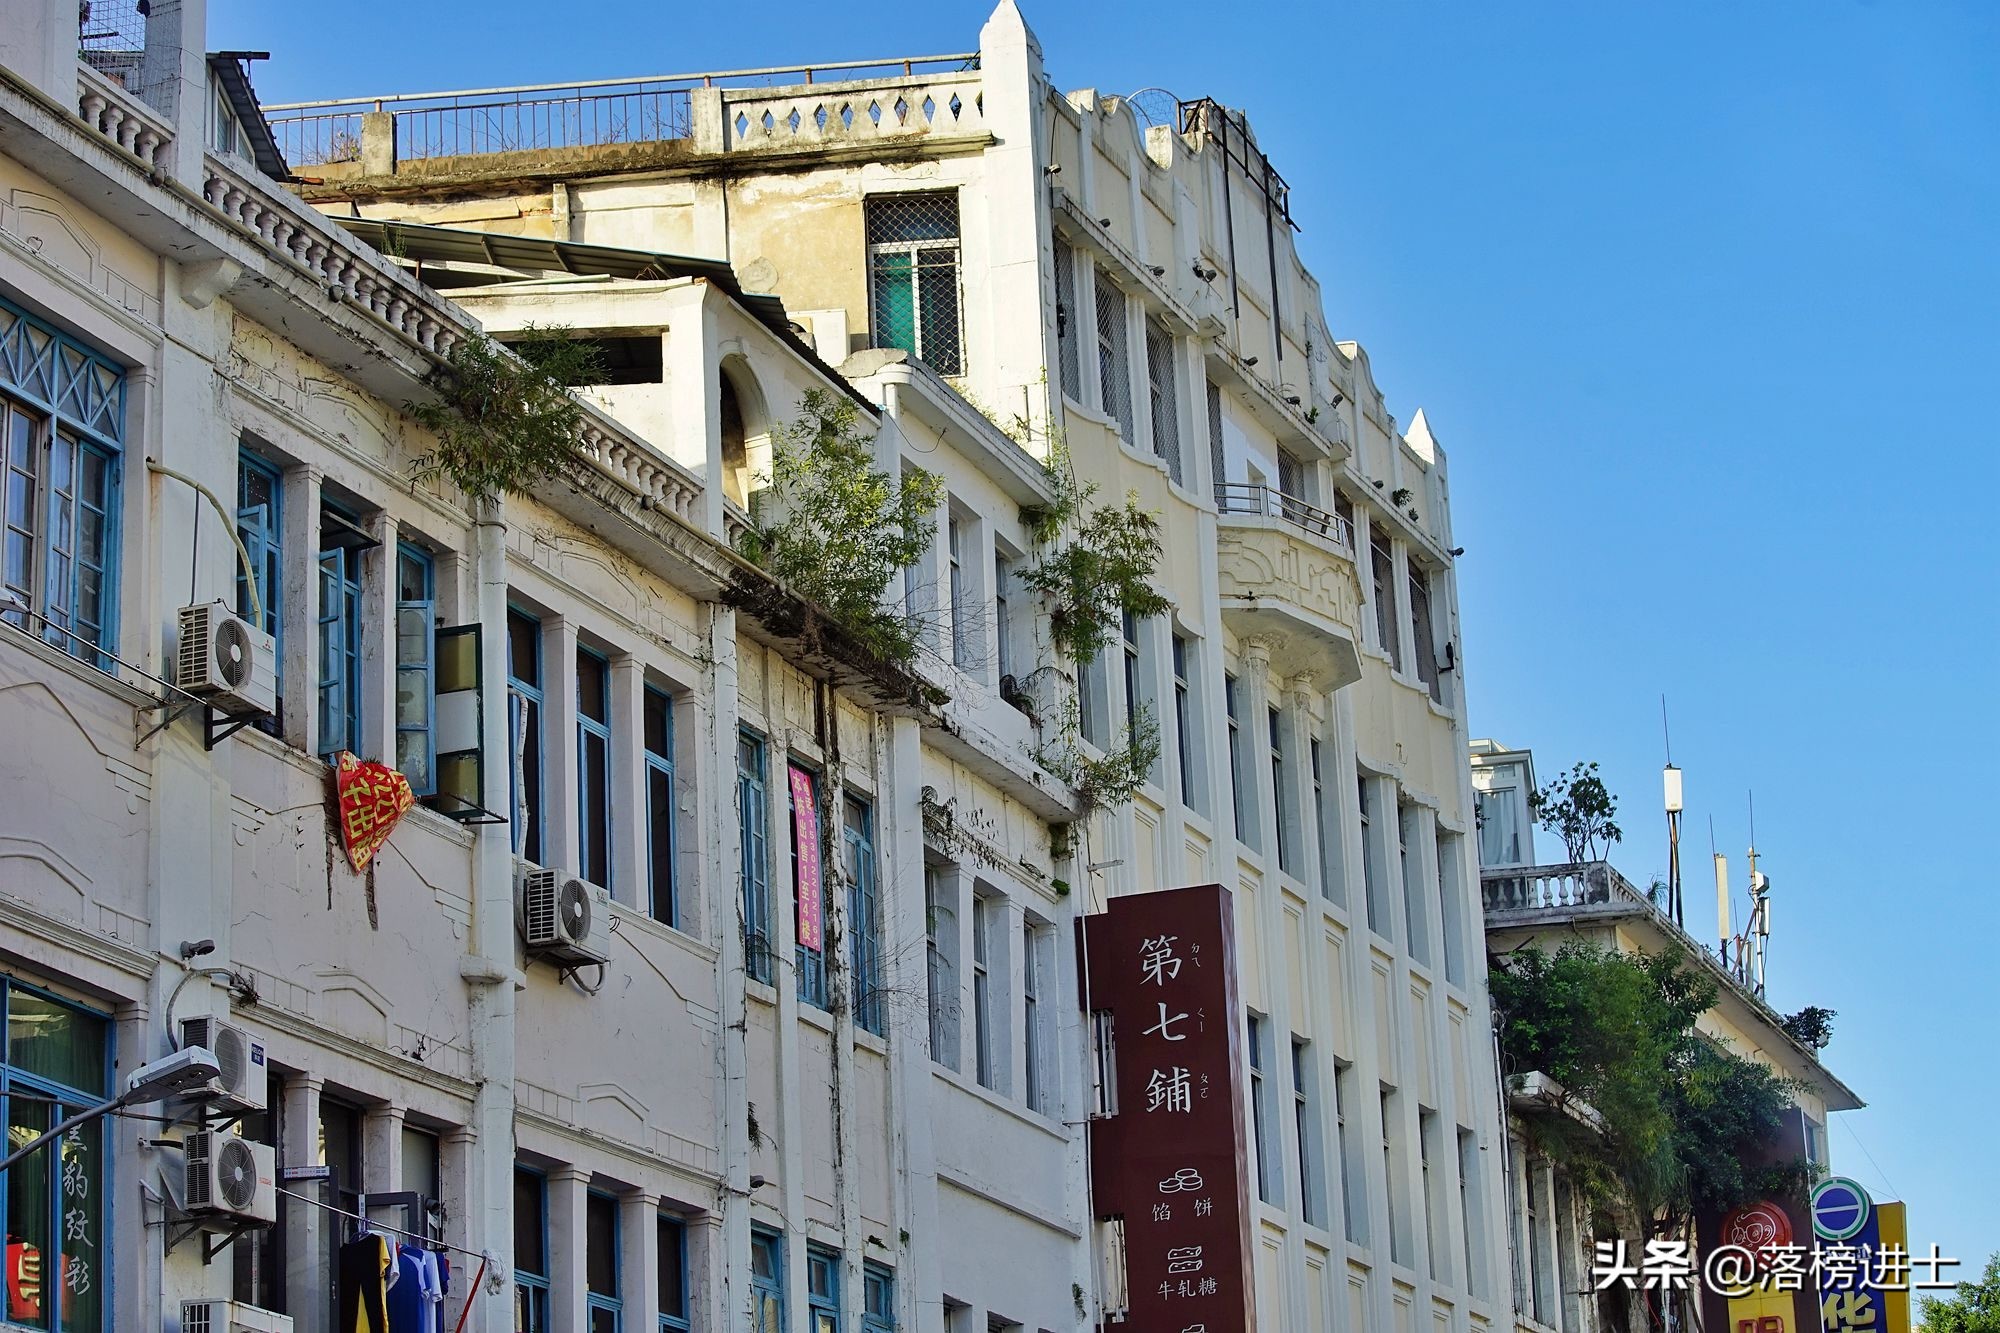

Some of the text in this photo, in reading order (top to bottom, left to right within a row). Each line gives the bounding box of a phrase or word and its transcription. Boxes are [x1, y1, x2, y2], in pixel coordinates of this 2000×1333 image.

[1138, 934, 1192, 1114] 第七鋪
[1157, 1277, 1218, 1301] 牛轧糖
